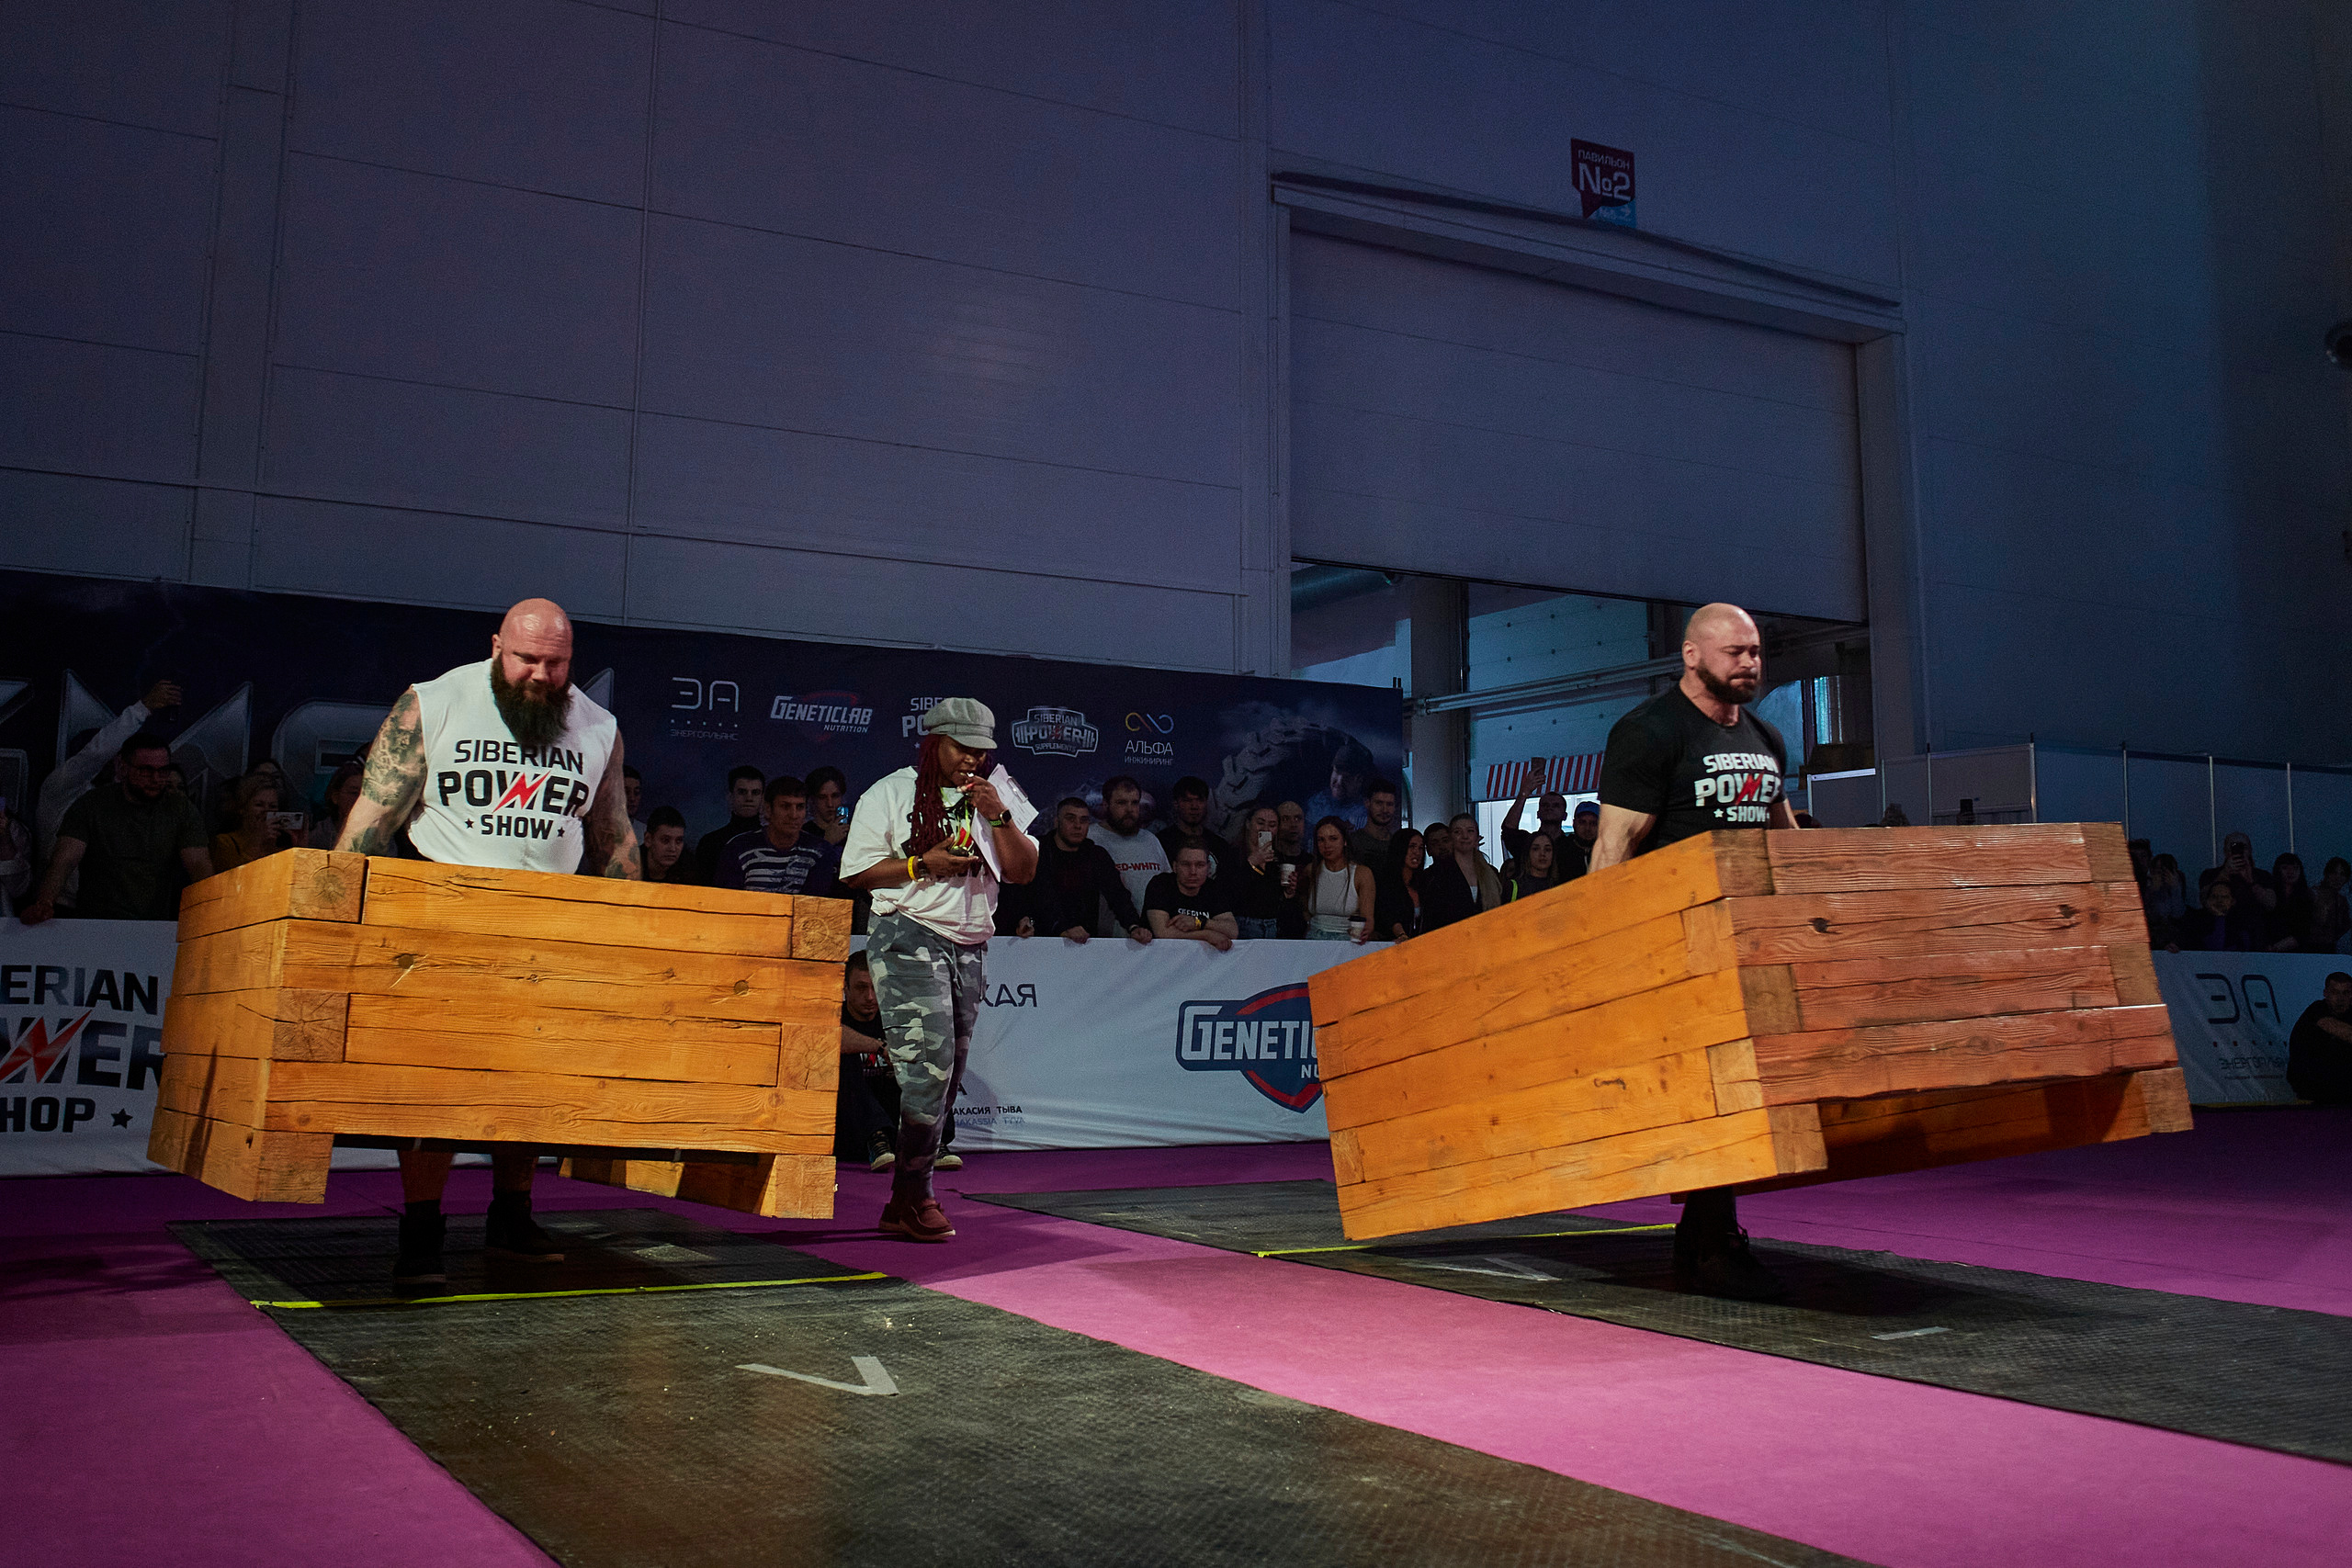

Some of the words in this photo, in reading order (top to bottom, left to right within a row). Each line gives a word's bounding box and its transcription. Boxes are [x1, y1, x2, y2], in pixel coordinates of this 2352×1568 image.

[1577, 149, 1631, 170] ПАВИЛЬОН
[1577, 162, 1632, 202] №2
[770, 694, 874, 726] GENETICLAB
[1034, 713, 1079, 727] SIBERIAN
[823, 724, 869, 734] NUTRITION
[454, 739, 583, 774] SIBERIAN
[1125, 739, 1174, 756] АЛЬФА
[1702, 752, 1780, 774] SIBERIAN
[437, 769, 590, 818] POWER
[1725, 805, 1767, 823] SHOW
[481, 814, 554, 840] SHOW
[1181, 1005, 1318, 1062] GENETI
[996, 1105, 1023, 1114] ТЫВА
